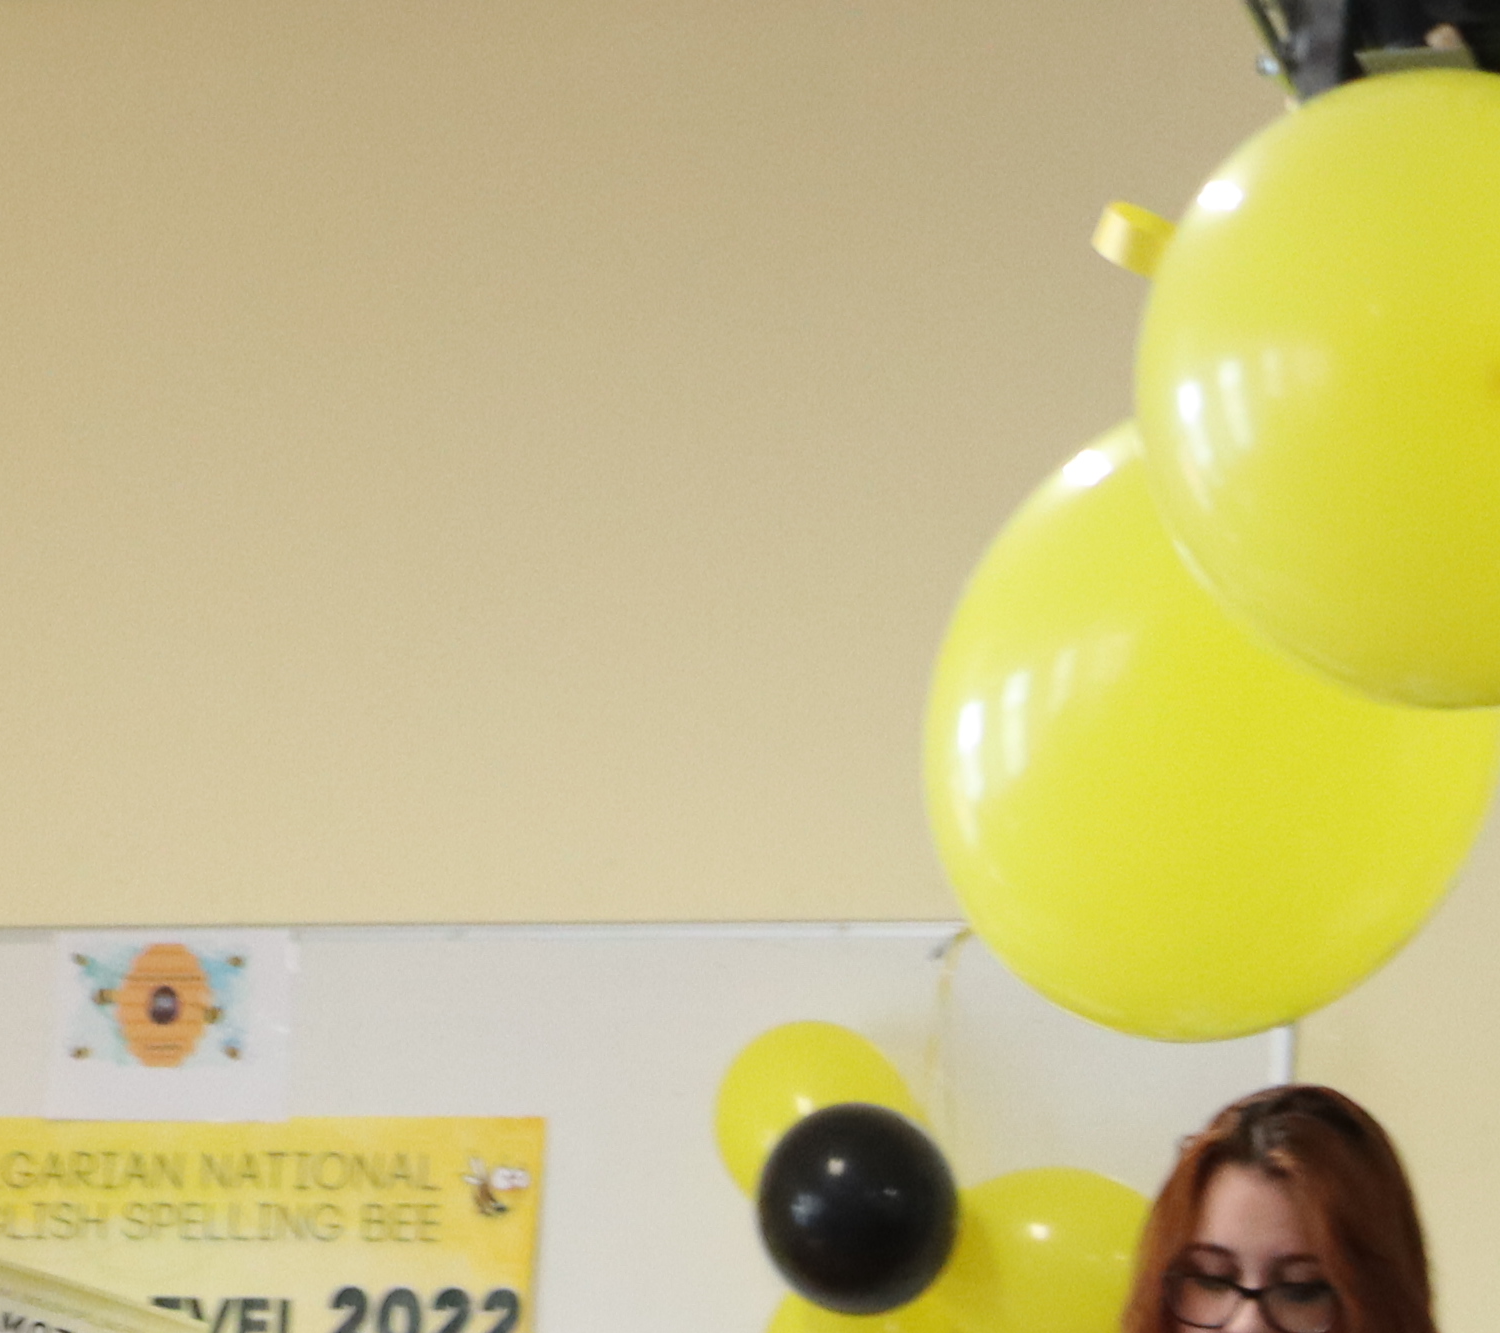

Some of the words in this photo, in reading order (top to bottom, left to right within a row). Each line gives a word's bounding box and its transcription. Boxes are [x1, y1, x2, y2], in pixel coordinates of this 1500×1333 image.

[201, 1150, 442, 1191] NATIONAL
[125, 1202, 344, 1241] SPELLING
[359, 1204, 443, 1242] BEE
